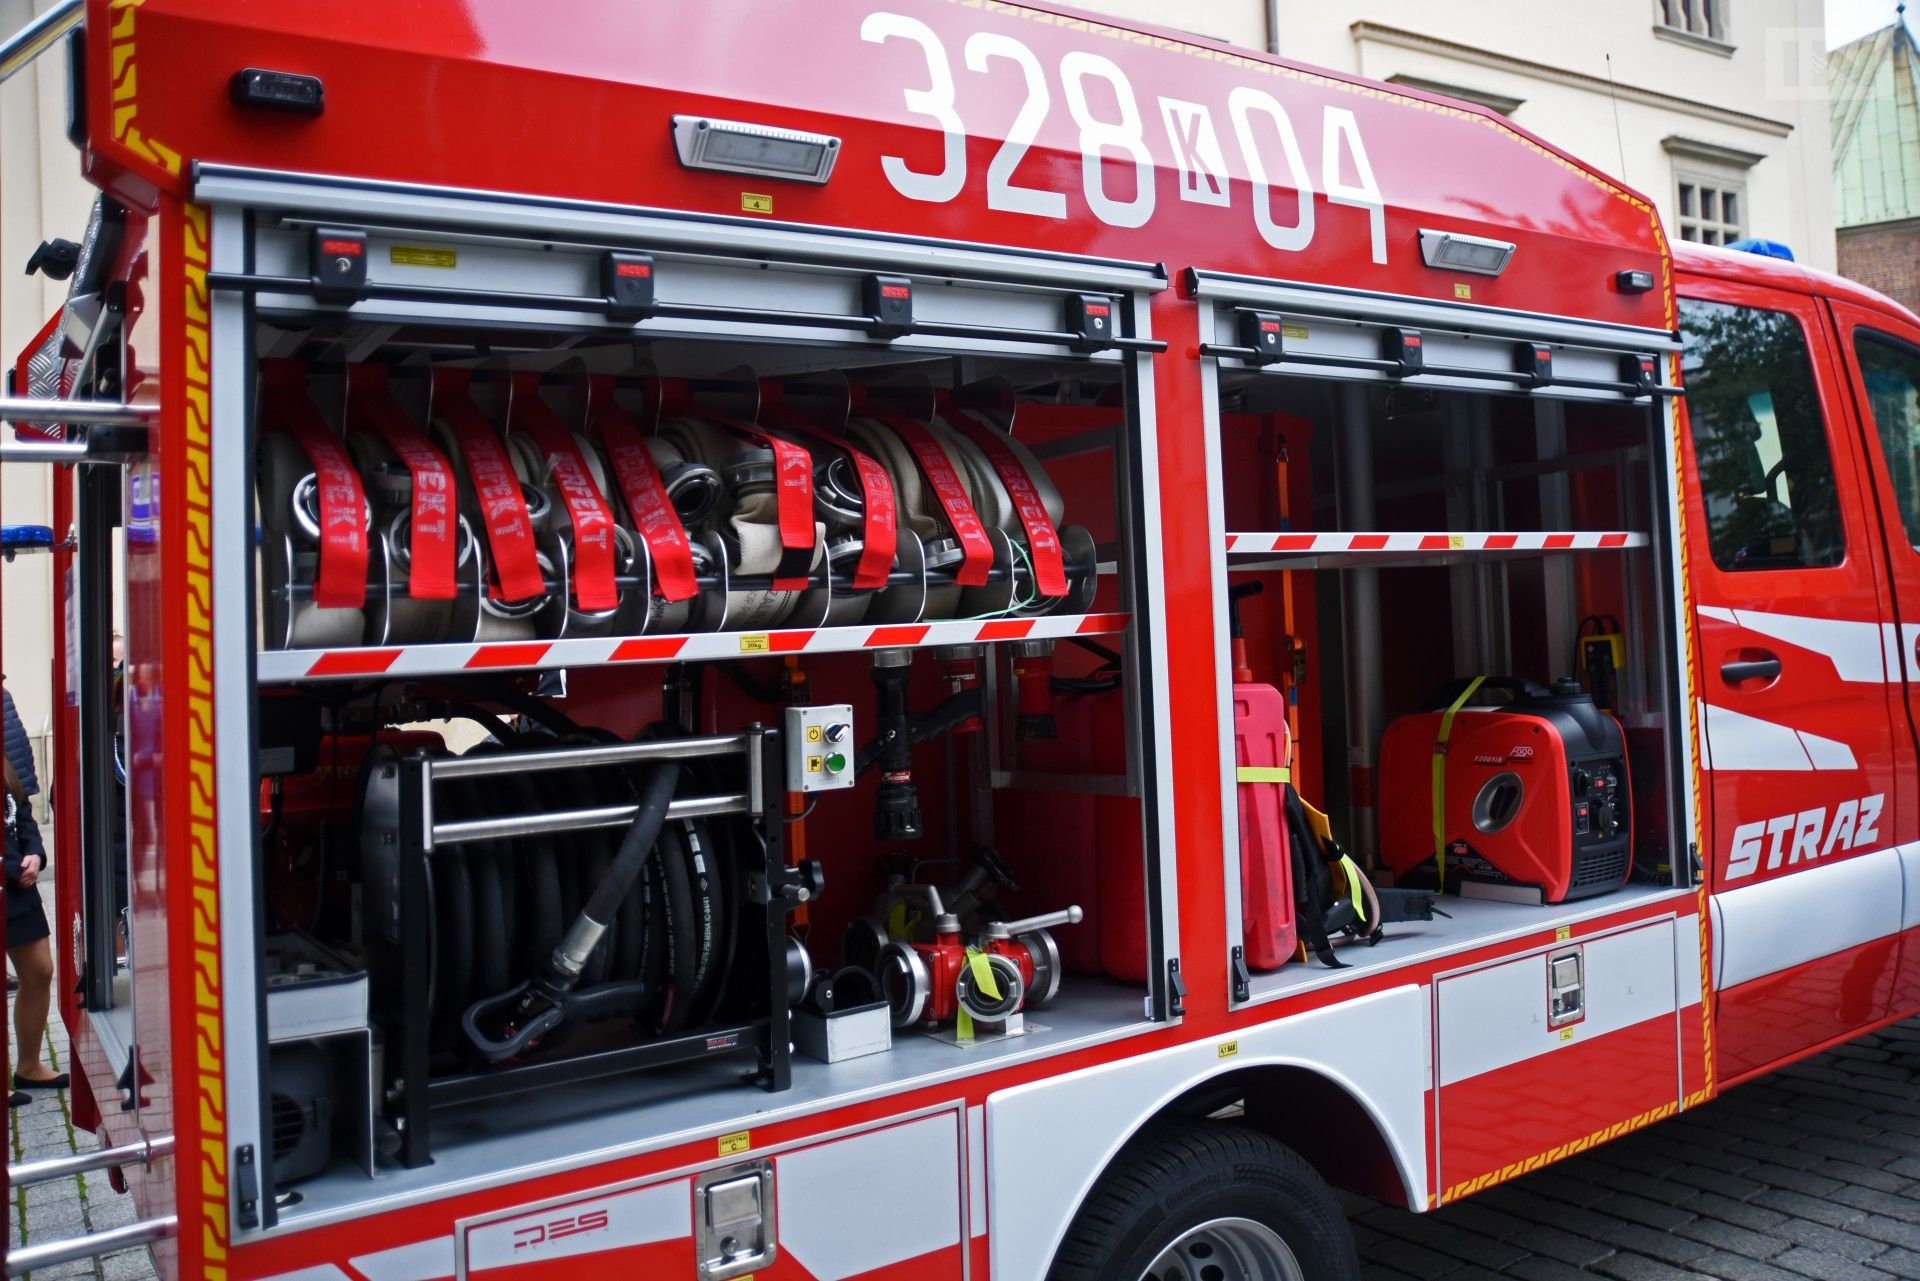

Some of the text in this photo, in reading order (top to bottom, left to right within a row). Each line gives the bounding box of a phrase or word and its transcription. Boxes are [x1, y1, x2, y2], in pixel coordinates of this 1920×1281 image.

[860, 11, 1388, 265] 328 K 04
[315, 441, 359, 553] FEKT
